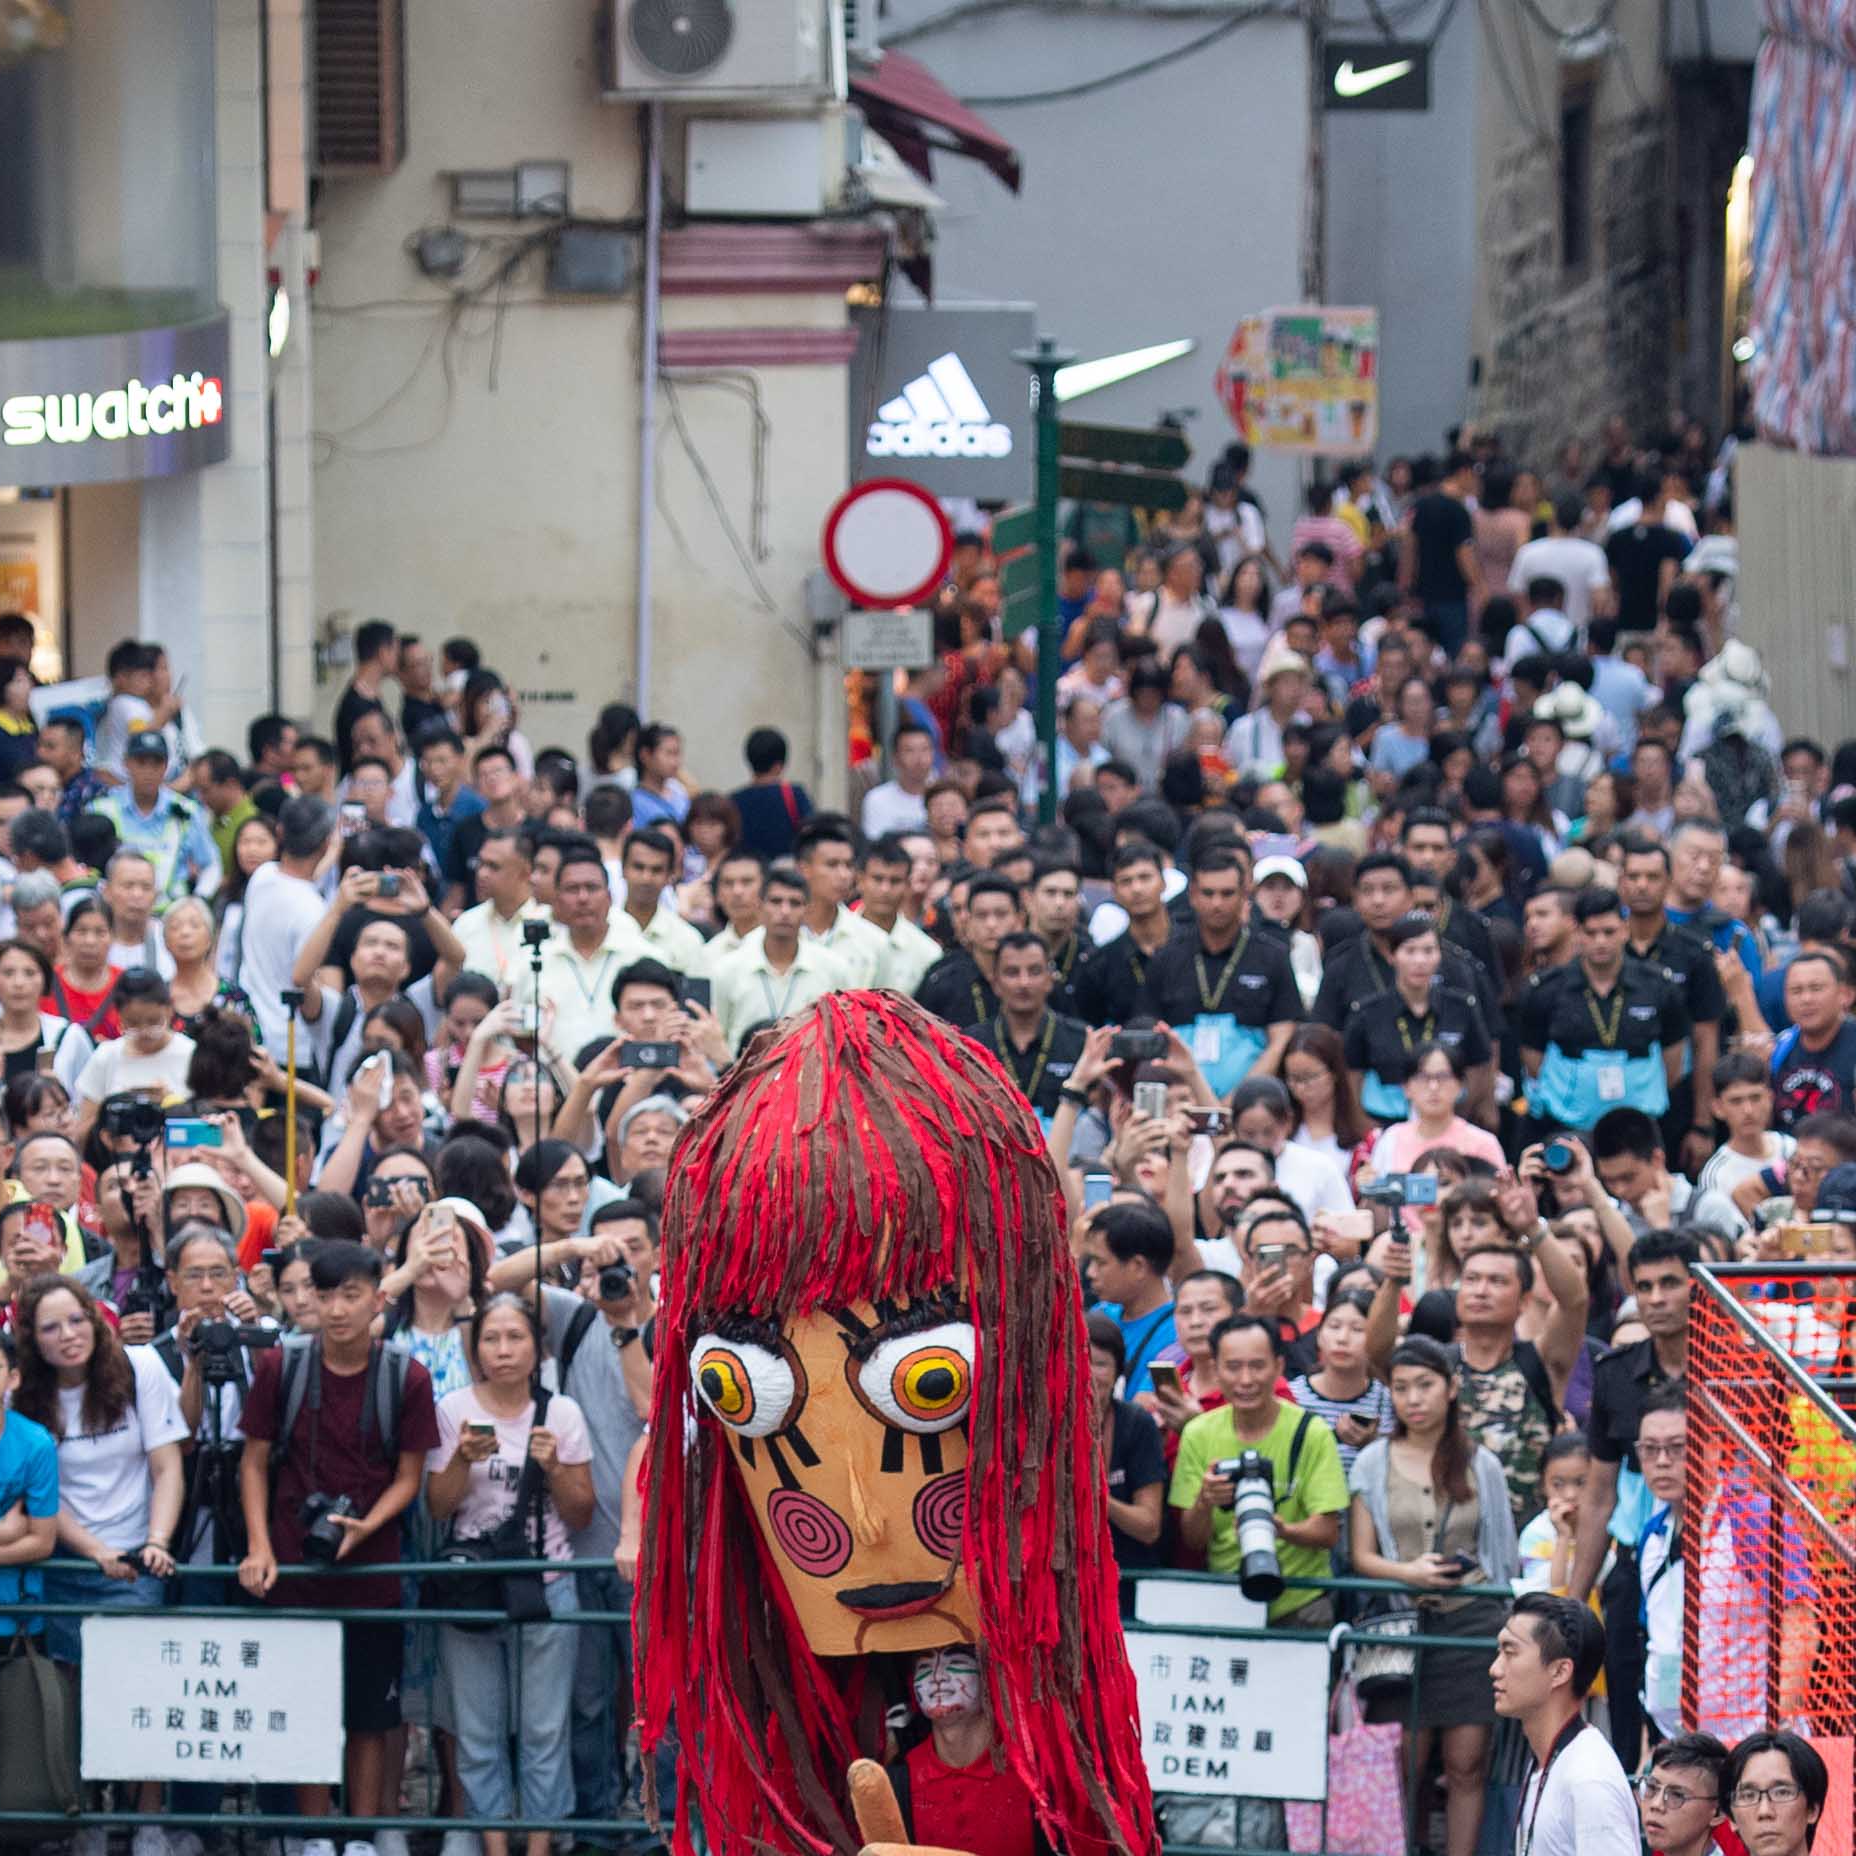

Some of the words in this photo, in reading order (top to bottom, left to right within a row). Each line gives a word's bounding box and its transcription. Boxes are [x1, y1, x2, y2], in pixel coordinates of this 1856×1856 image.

[2, 371, 204, 446] swatch
[866, 421, 1013, 458] adidas
[161, 1640, 260, 1669] 市政署
[1151, 1654, 1249, 1687] 市政署
[183, 1679, 239, 1697] IAM
[1171, 1694, 1225, 1714] IAM
[131, 1707, 288, 1733] 市政建設廳
[176, 1741, 243, 1760] DEM
[1153, 1721, 1273, 1753] 政建設廳
[1163, 1755, 1229, 1779] DEM
